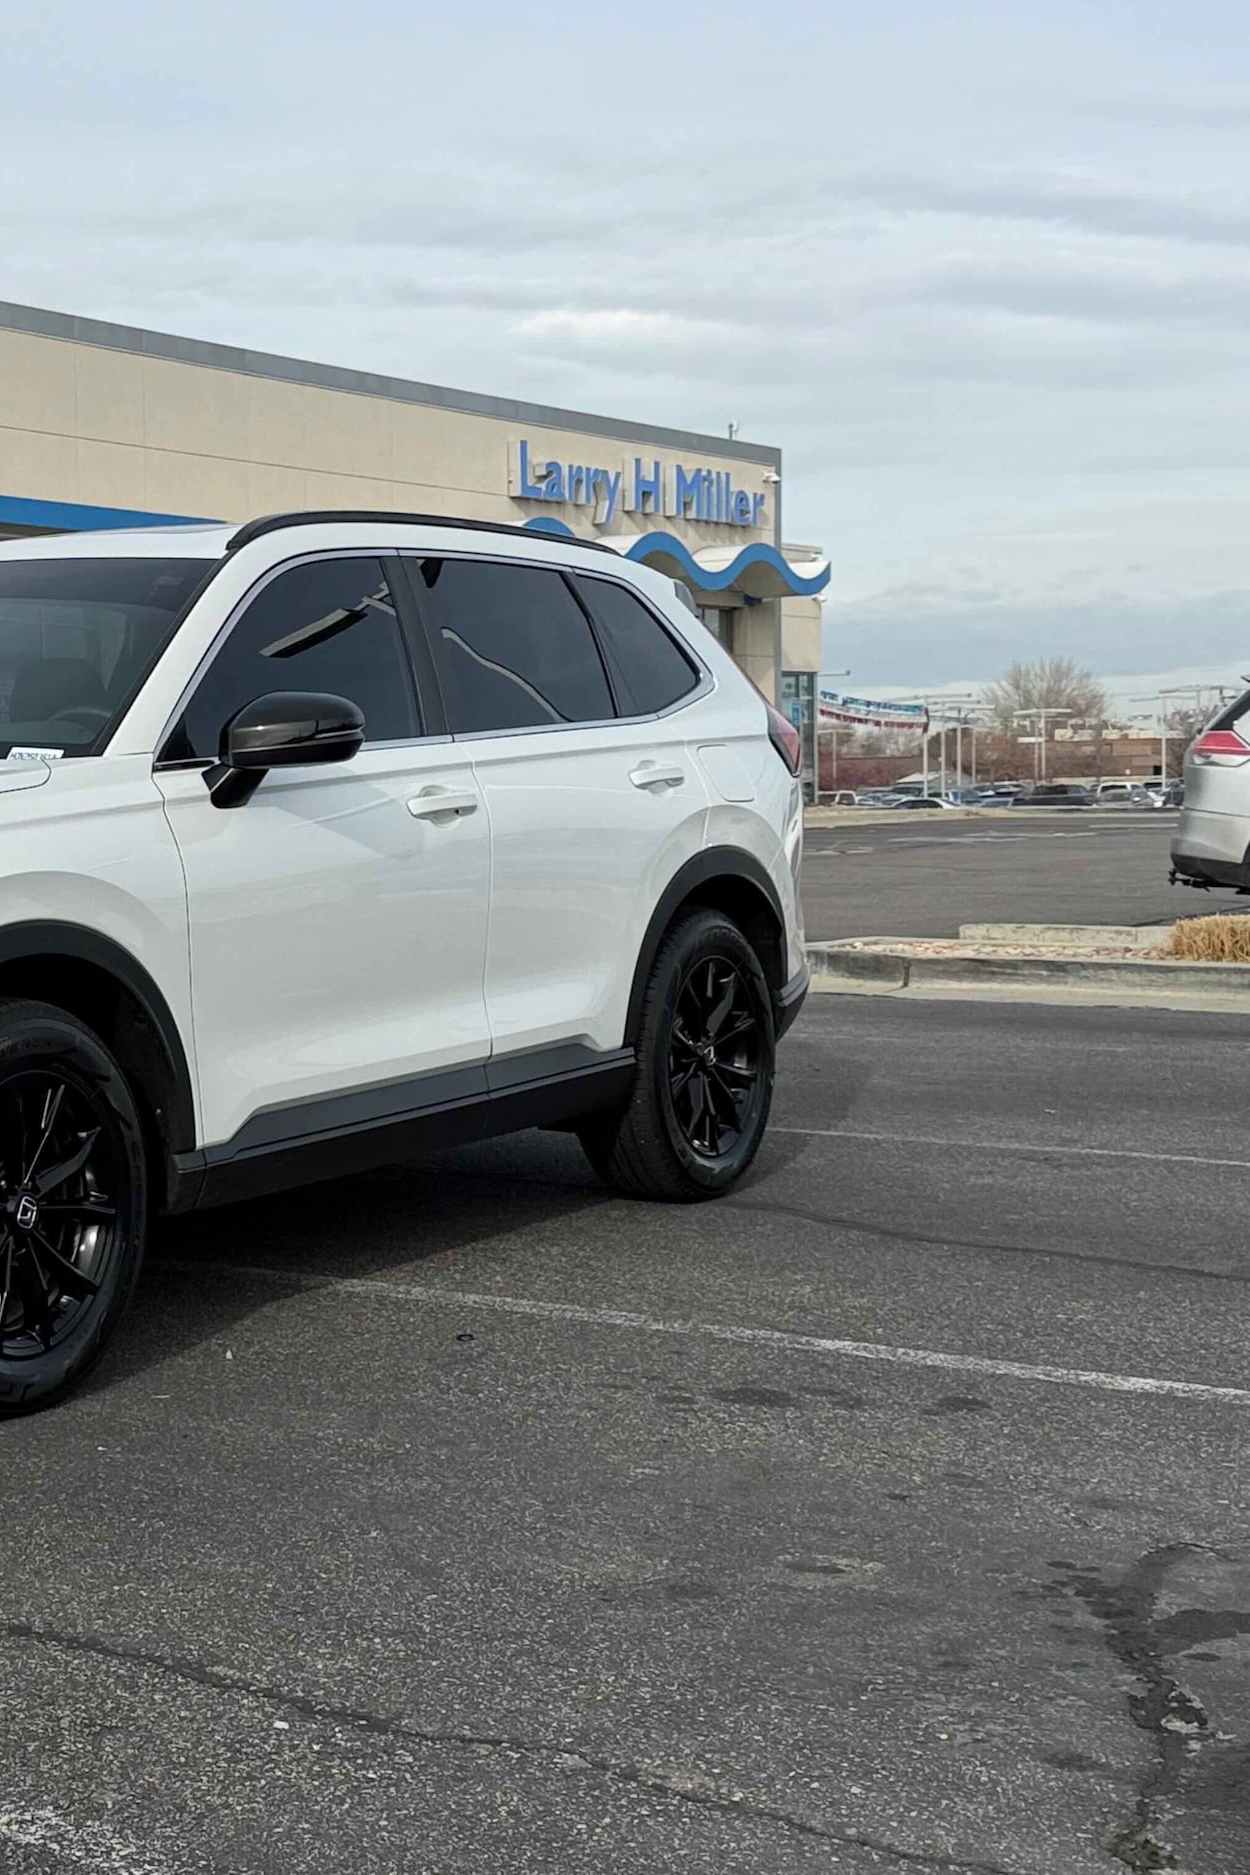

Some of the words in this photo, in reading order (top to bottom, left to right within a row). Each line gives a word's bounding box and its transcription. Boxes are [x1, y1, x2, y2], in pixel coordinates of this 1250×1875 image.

[516, 439, 622, 524] Larry
[630, 457, 661, 513] H
[672, 463, 766, 527] Miller
